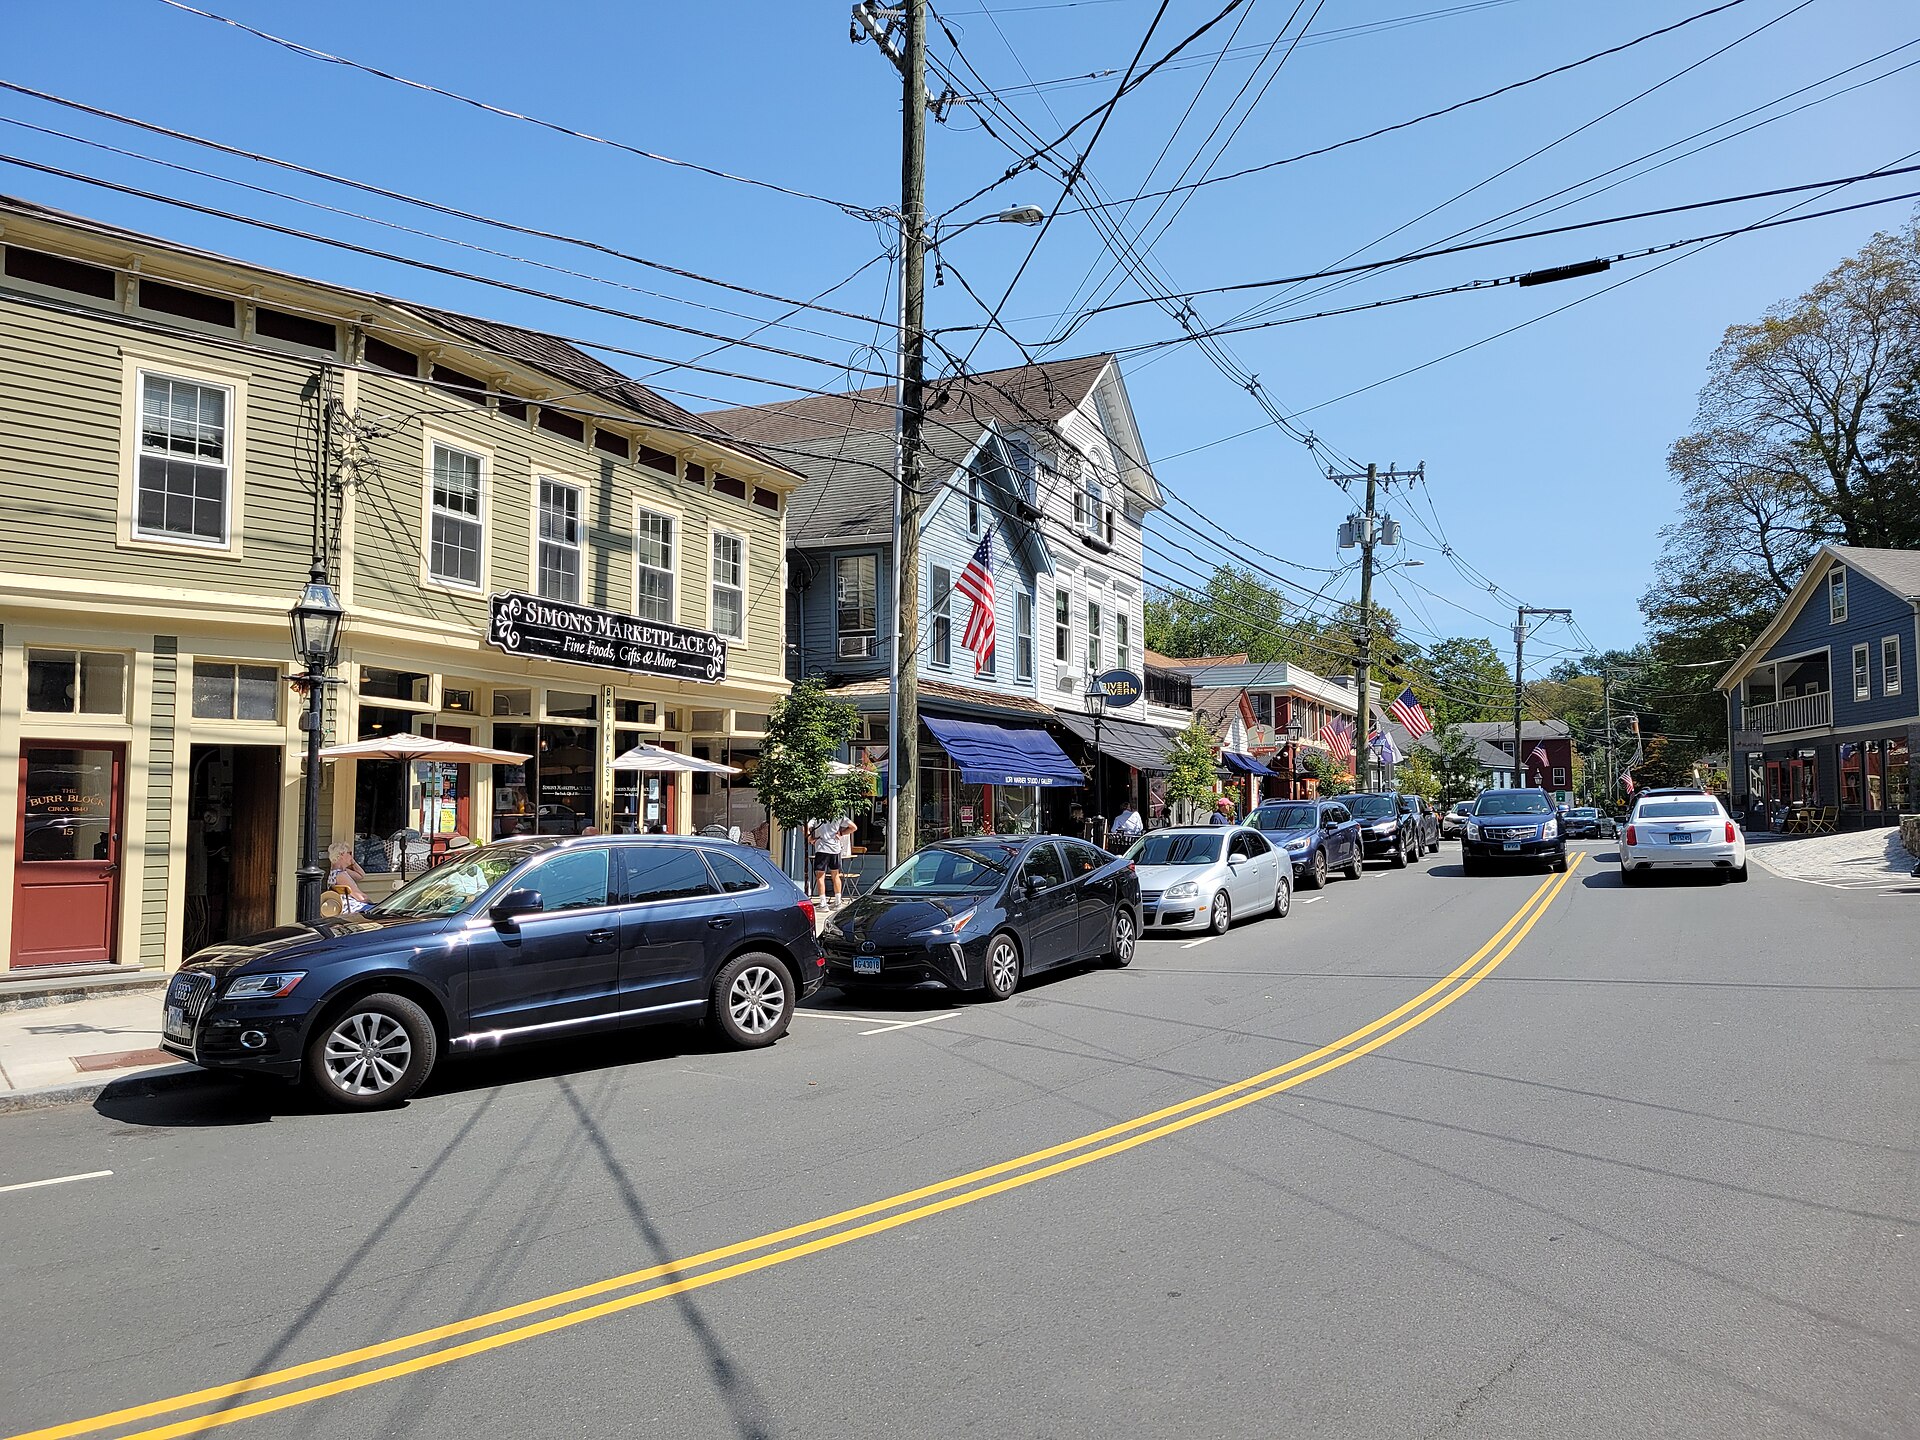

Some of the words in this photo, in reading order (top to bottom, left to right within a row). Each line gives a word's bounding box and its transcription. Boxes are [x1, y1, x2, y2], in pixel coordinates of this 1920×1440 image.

[526, 601, 592, 633] SIMON'S
[596, 614, 705, 653] MARKETPLACE
[563, 635, 586, 654] Fine
[587, 640, 616, 662] Foods,
[619, 646, 642, 666] Gifts
[643, 651, 655, 665] &
[654, 652, 677, 668] More
[30, 795, 63, 807] BURR
[67, 795, 105, 807] BLOCK
[62, 828, 75, 836] 15
